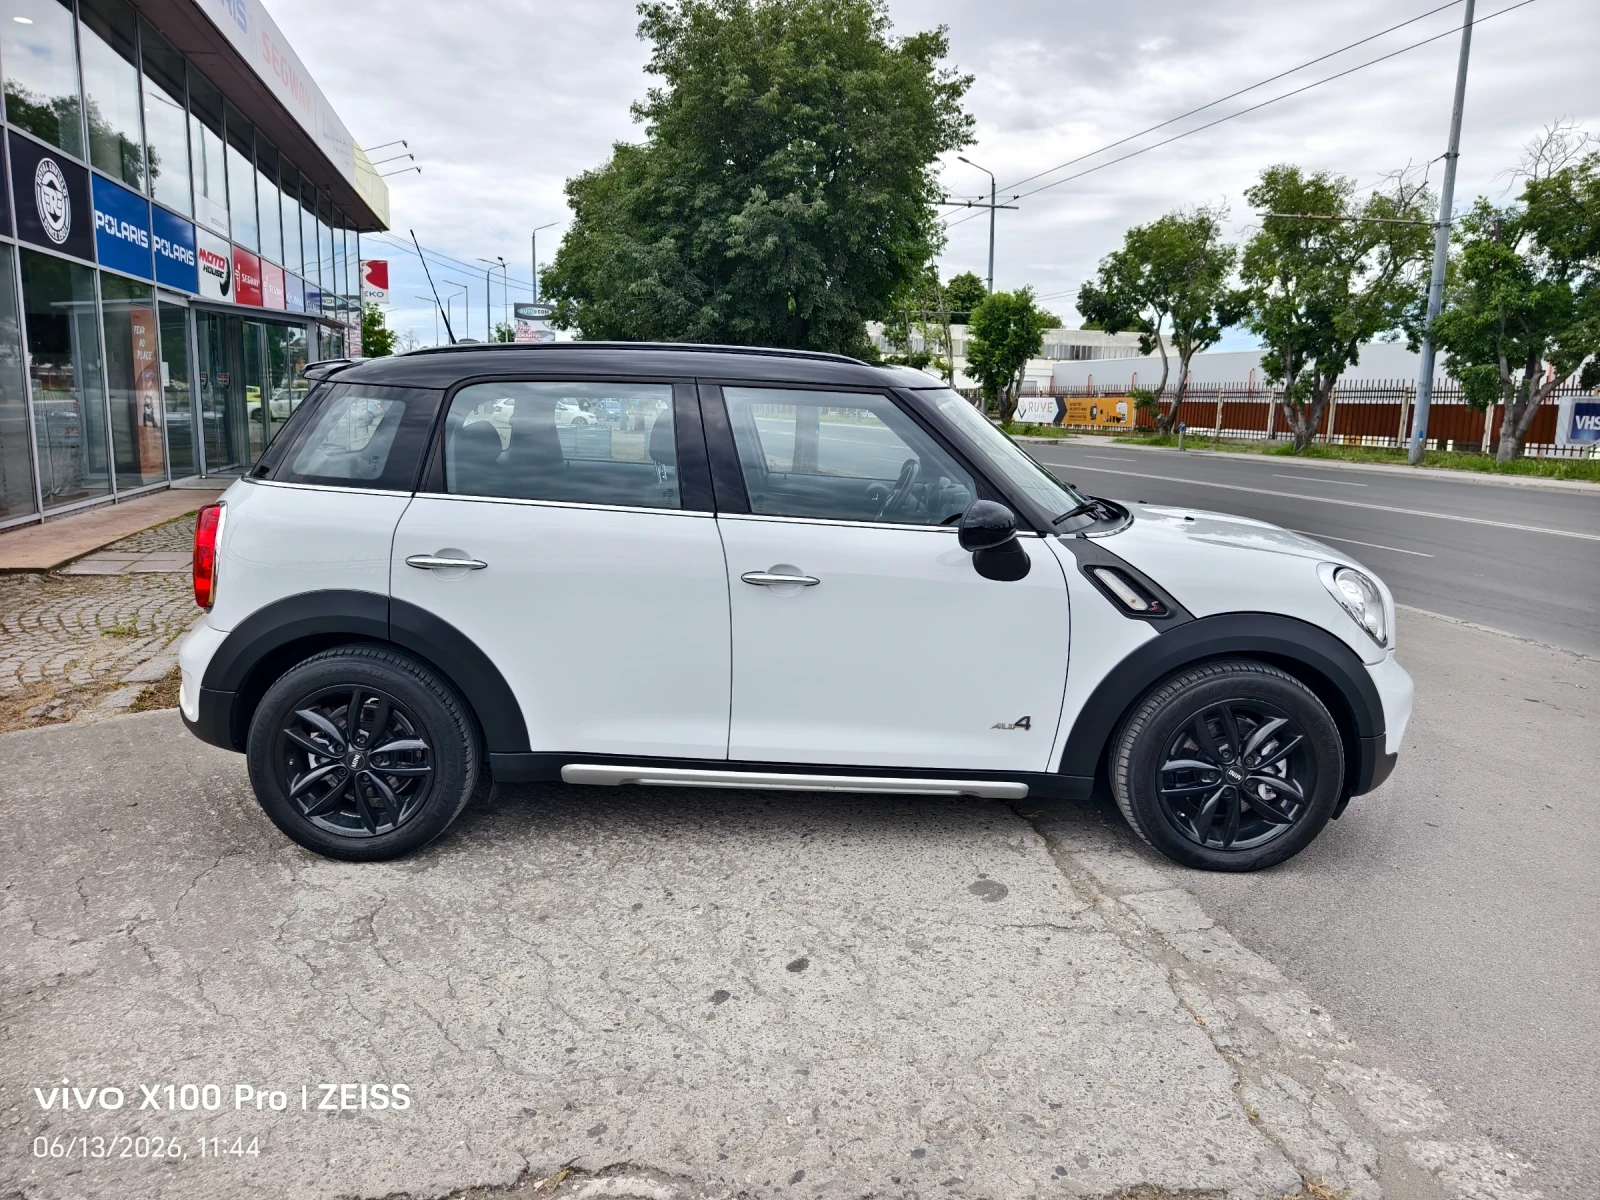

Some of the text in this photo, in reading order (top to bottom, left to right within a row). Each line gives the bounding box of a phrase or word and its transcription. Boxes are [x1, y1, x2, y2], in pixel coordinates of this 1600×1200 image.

[261, 31, 311, 116] SEGWAY
[95, 209, 149, 249] POLARIS
[153, 235, 195, 267] POLARIS
[198, 248, 226, 270] MOTO
[203, 264, 225, 279] HOUSE
[241, 273, 260, 288] SEGWAY
[133, 325, 146, 335] FEAR
[136, 350, 153, 360] PLACE
